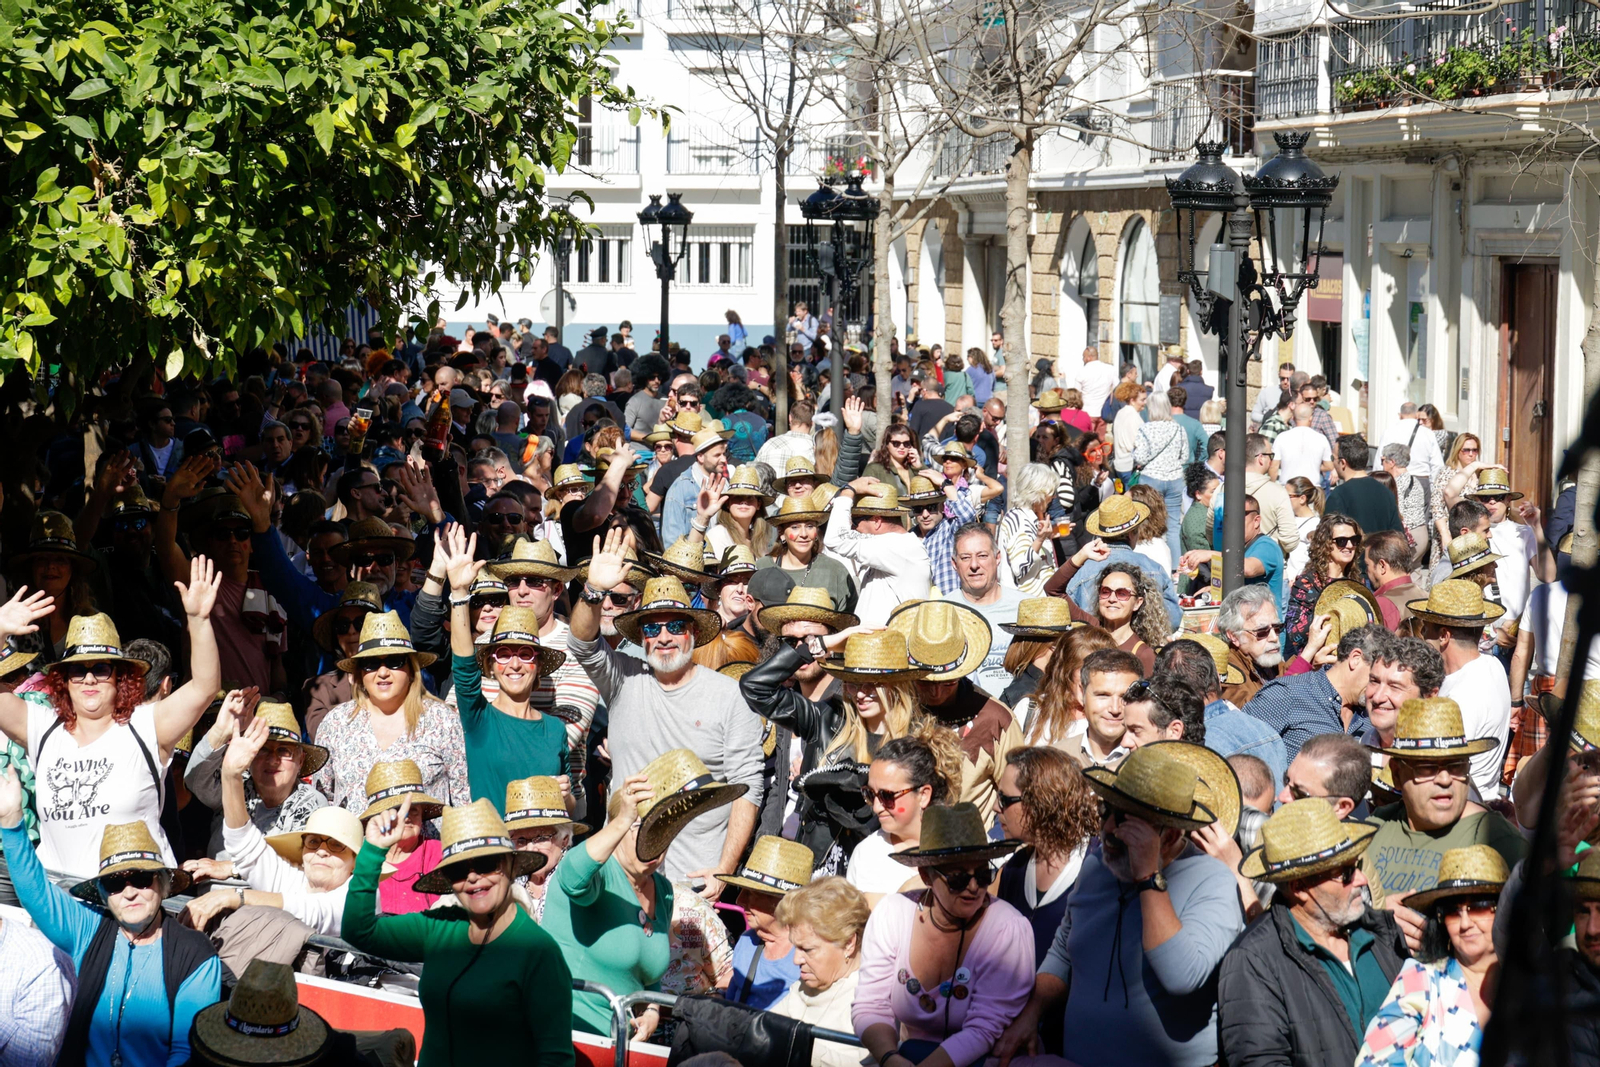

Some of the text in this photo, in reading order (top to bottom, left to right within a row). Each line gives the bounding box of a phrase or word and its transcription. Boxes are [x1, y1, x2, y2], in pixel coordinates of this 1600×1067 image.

[74, 757, 107, 773] Who
[78, 804, 110, 819] Are
[1374, 846, 1443, 870] SOUTHER
[1376, 866, 1439, 892] Quarte
